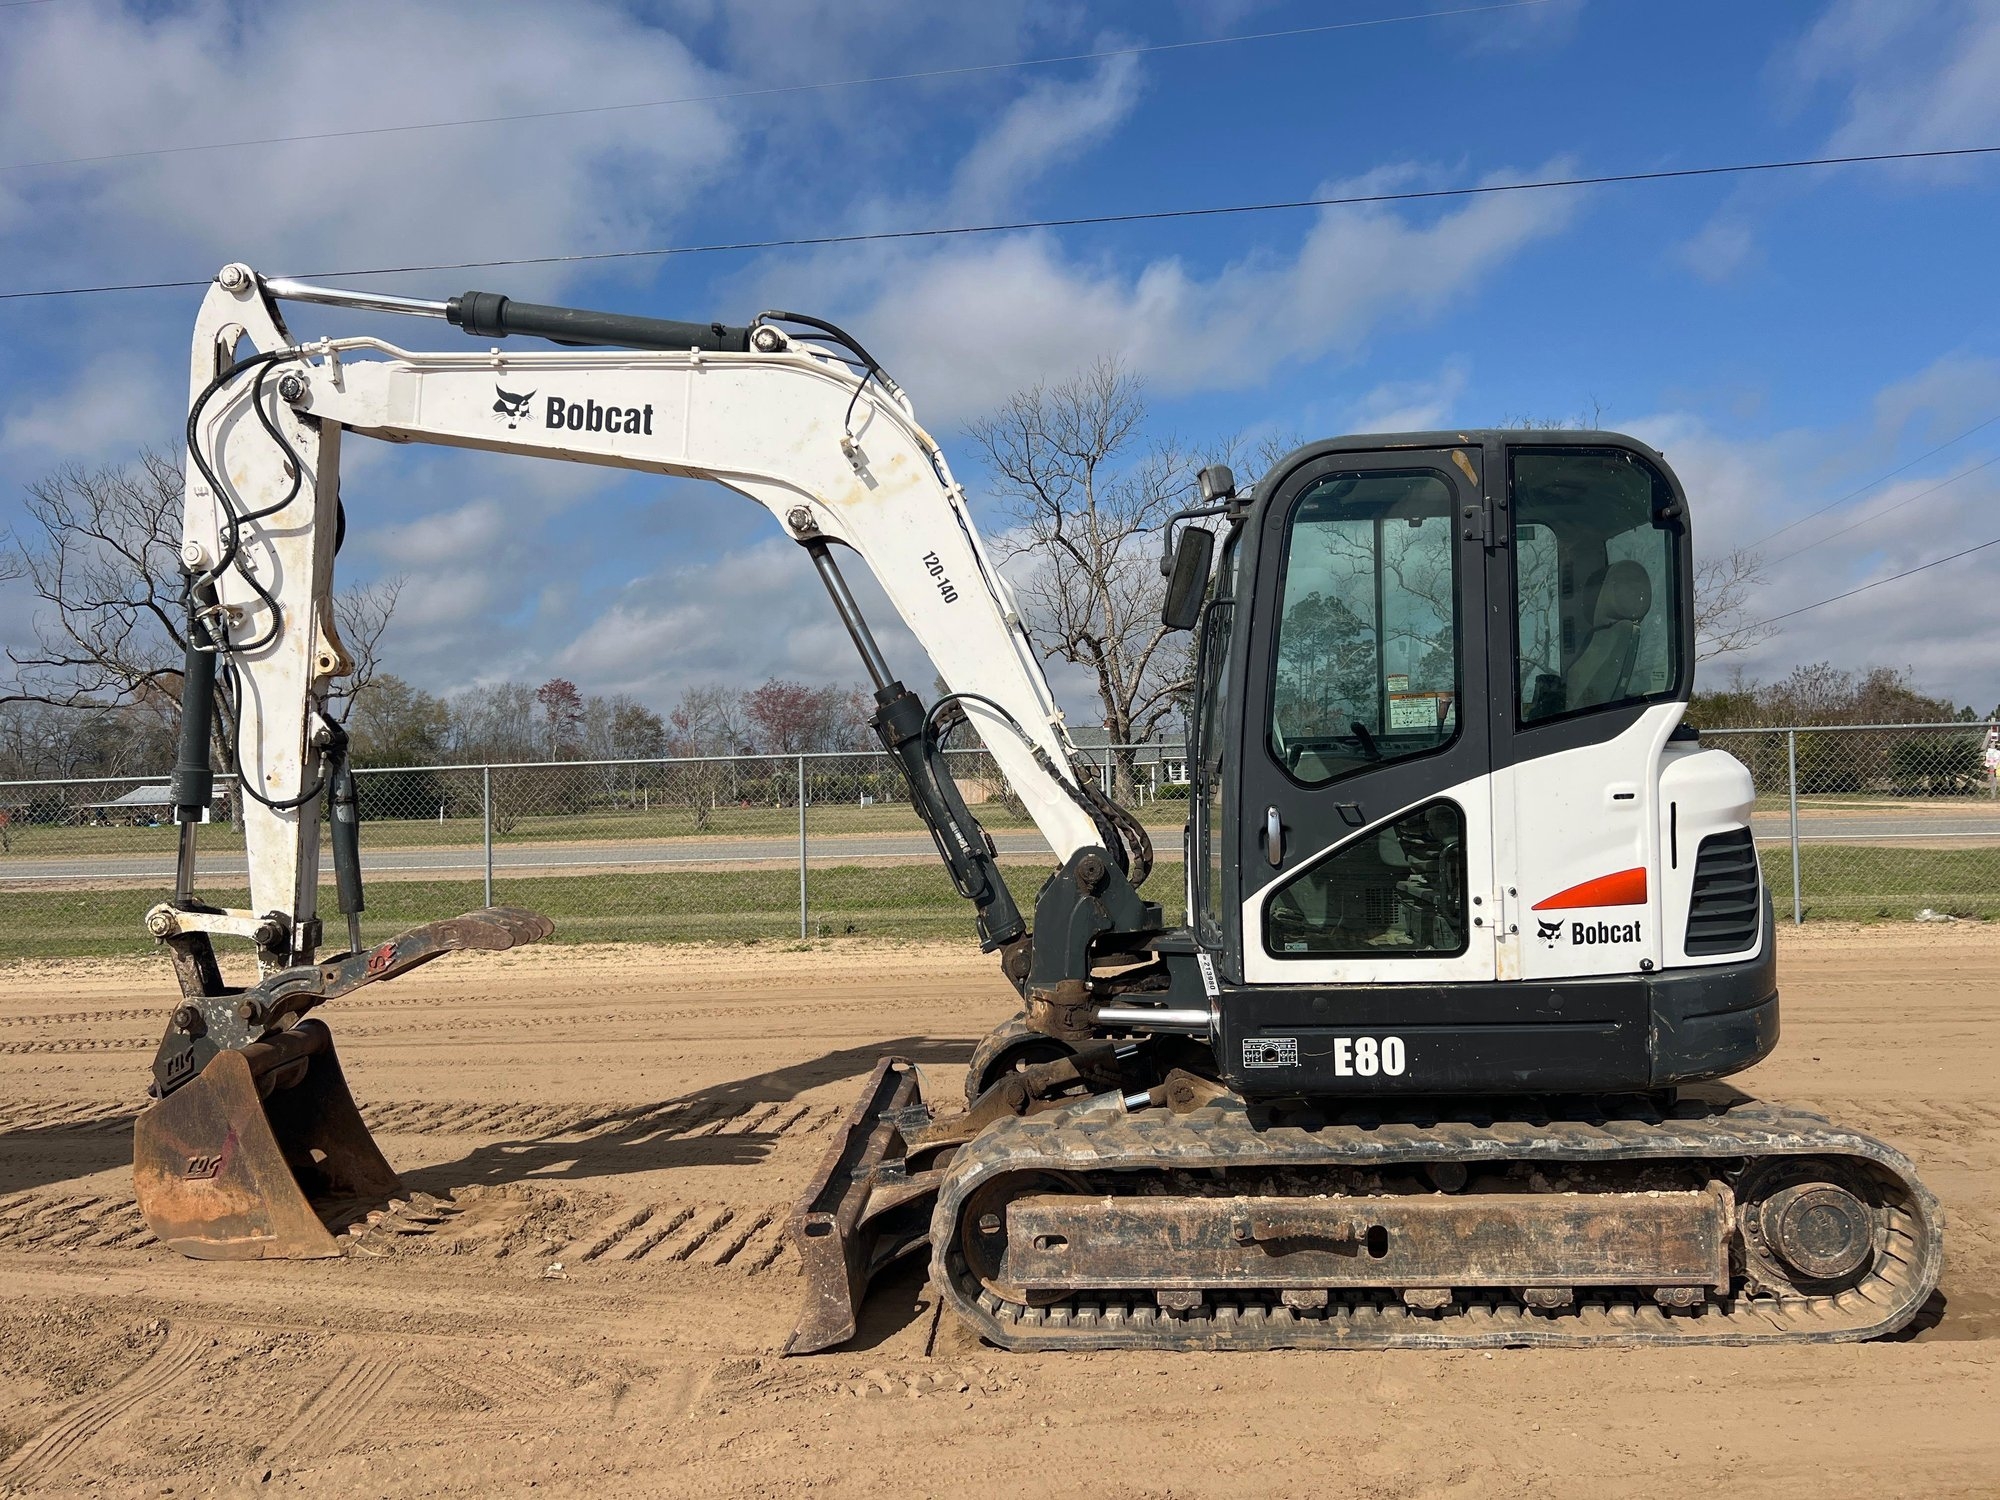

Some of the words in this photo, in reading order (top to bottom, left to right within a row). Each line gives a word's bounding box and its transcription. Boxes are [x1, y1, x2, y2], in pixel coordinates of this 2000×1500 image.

[545, 396, 654, 435] Bobcat
[922, 550, 959, 604] 120-140
[1571, 920, 1642, 946] Bobcat
[1203, 962, 1216, 990] 213980
[1333, 1036, 1406, 1077] E80
